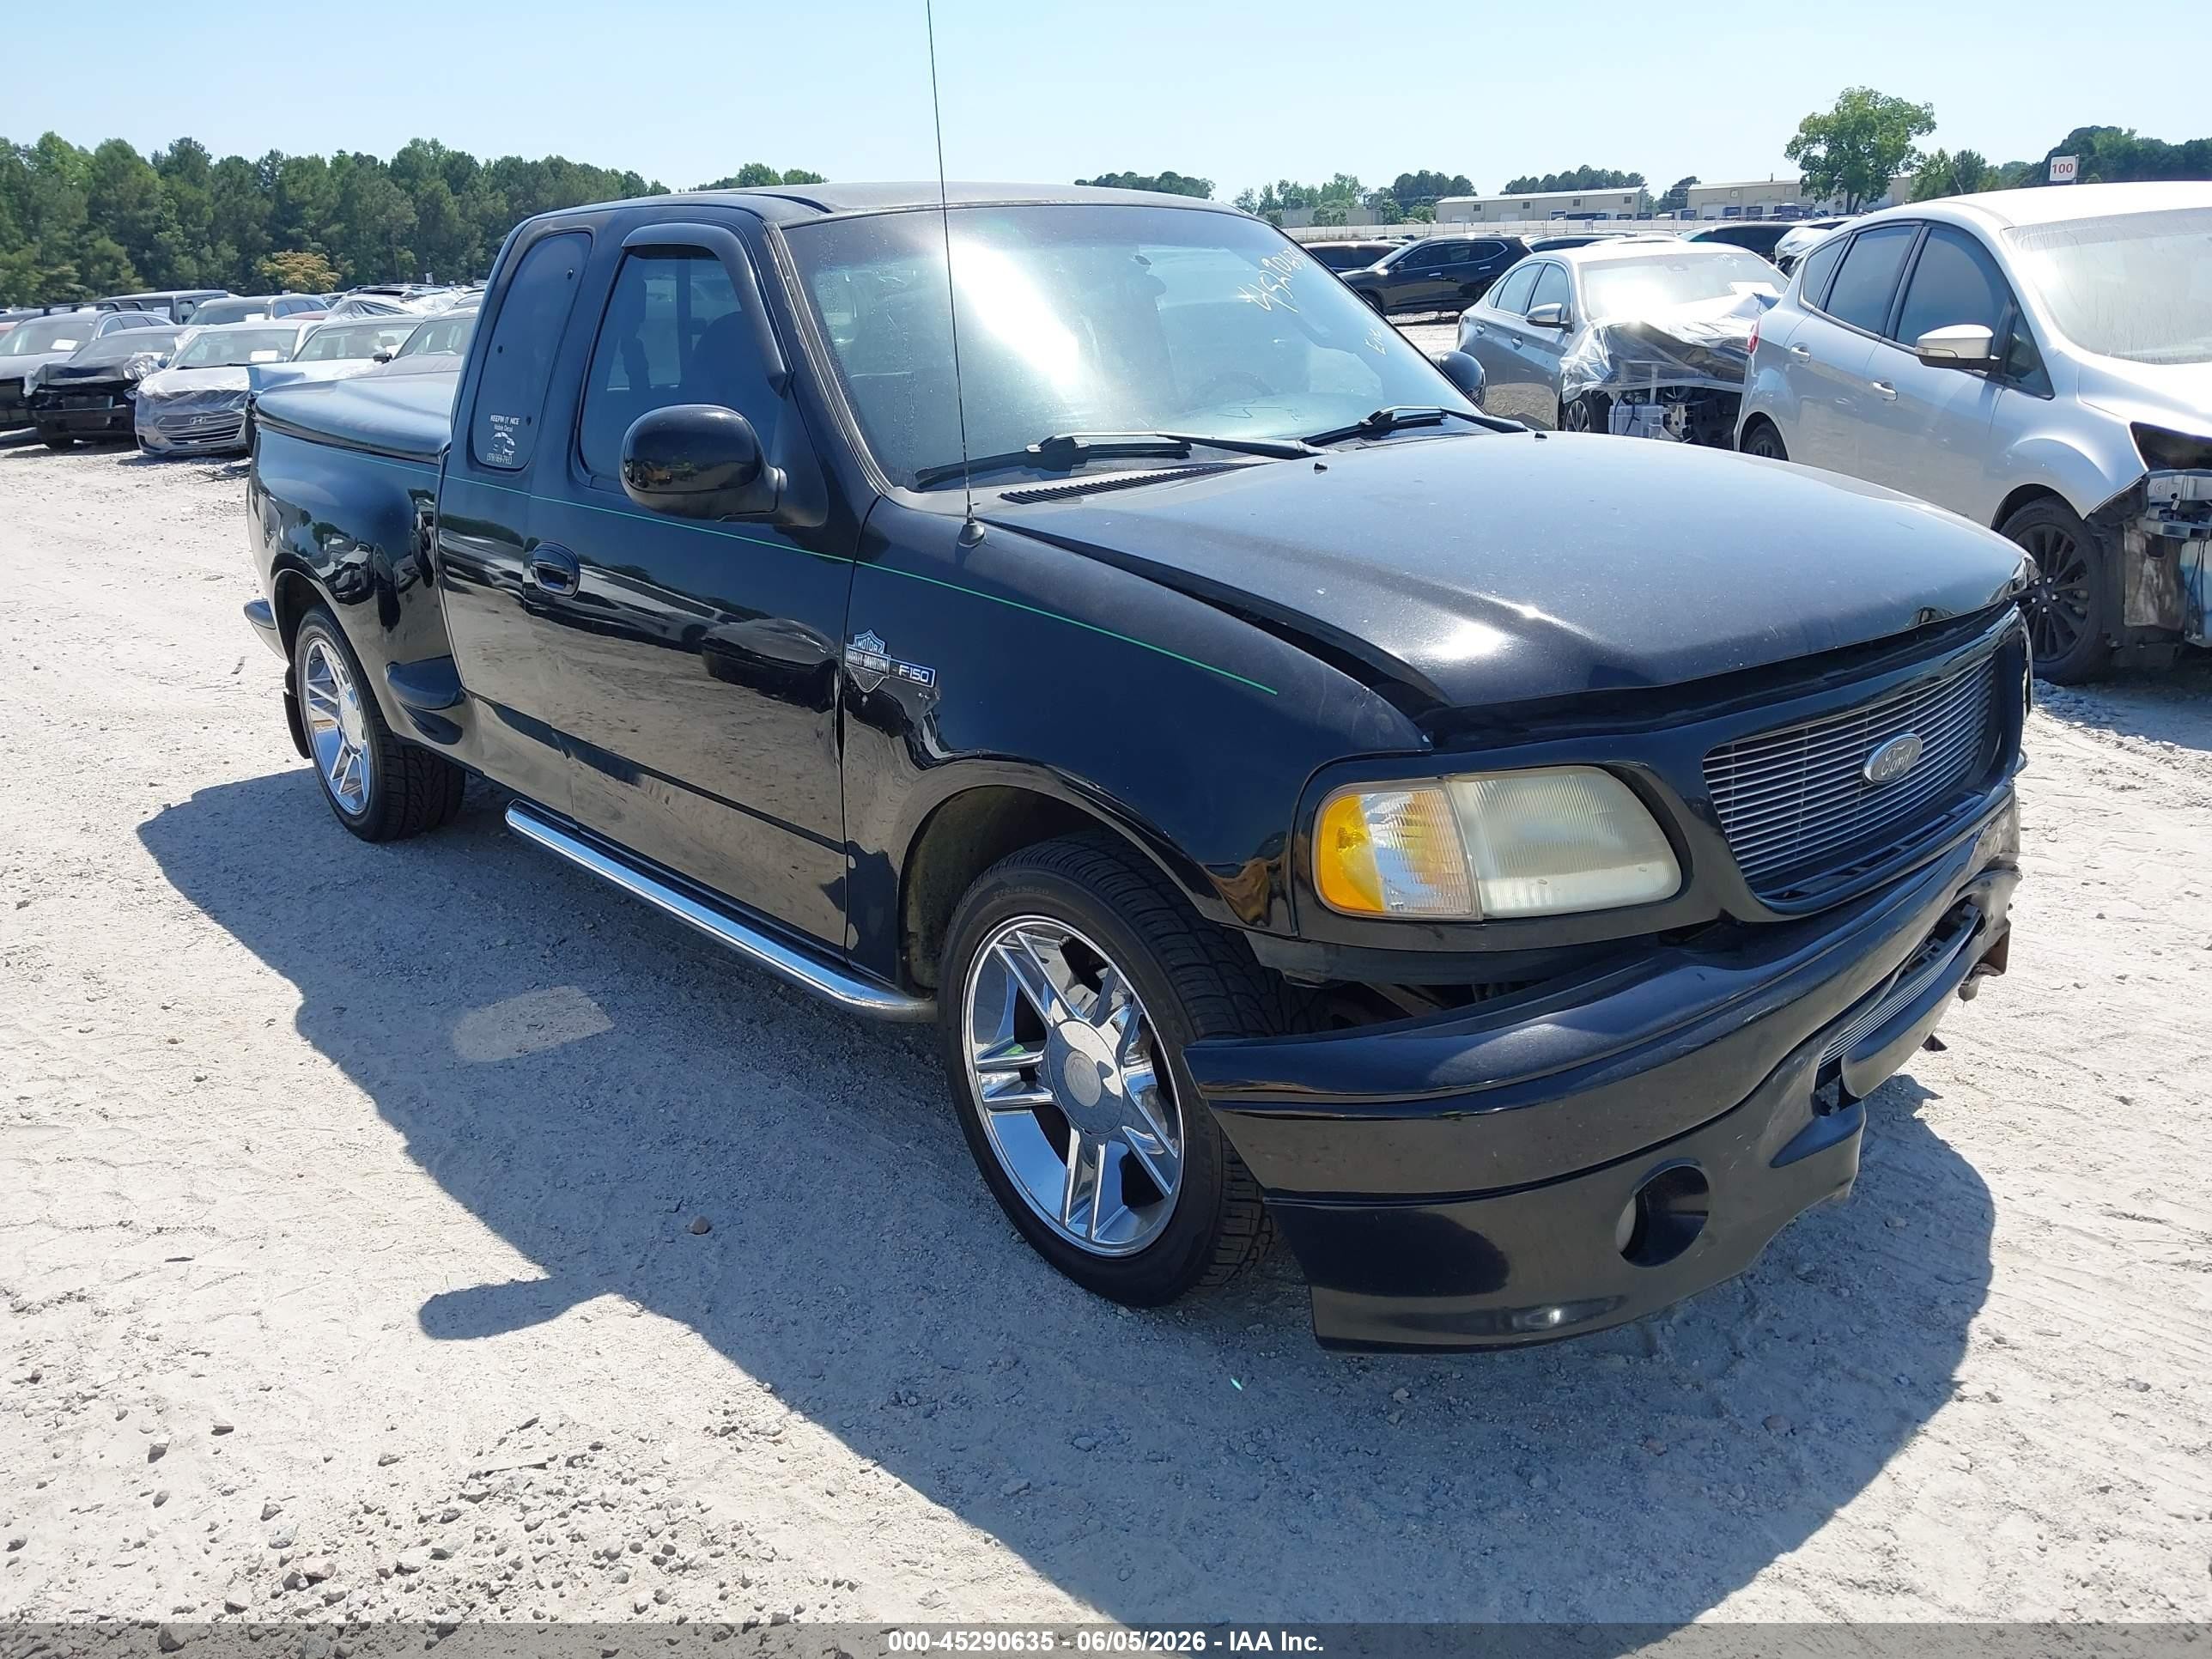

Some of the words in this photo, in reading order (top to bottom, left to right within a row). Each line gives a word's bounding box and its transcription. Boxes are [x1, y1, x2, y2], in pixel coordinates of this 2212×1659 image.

[2051, 163, 2074, 173] 100
[857, 635, 878, 653] MOTOR
[846, 648, 887, 672] HARLEY-DAVIDSON
[898, 664, 930, 684] F-150
[1880, 744, 1913, 777] Ford
